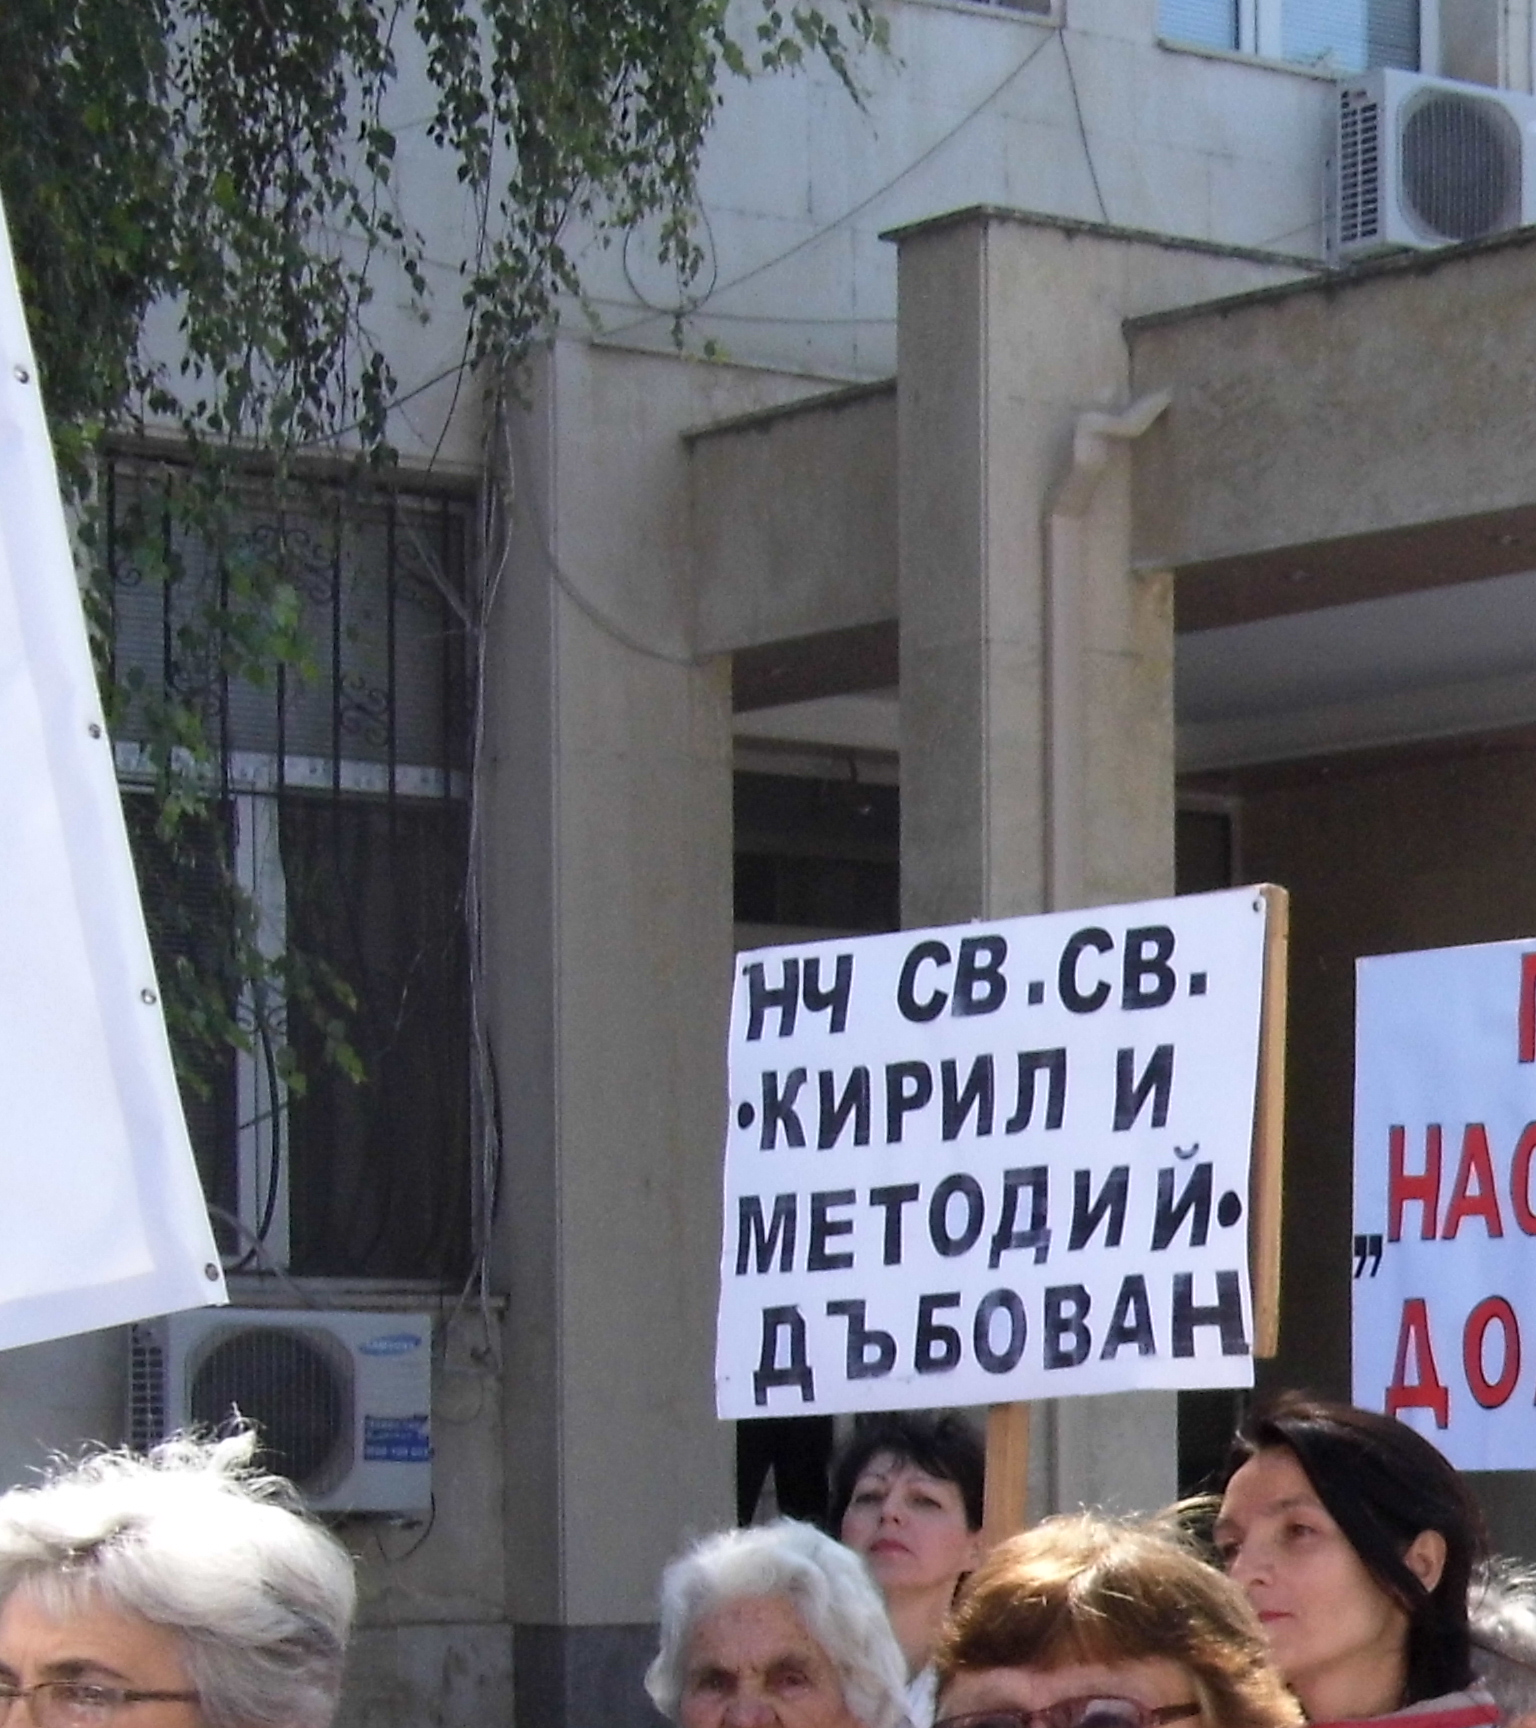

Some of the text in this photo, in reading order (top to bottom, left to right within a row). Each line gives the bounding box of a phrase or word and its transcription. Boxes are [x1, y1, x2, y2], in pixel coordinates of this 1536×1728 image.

[745, 953, 853, 1041] НЧ
[1112, 1044, 1175, 1132] И
[753, 1270, 1251, 1406] ДЪБОВАН
